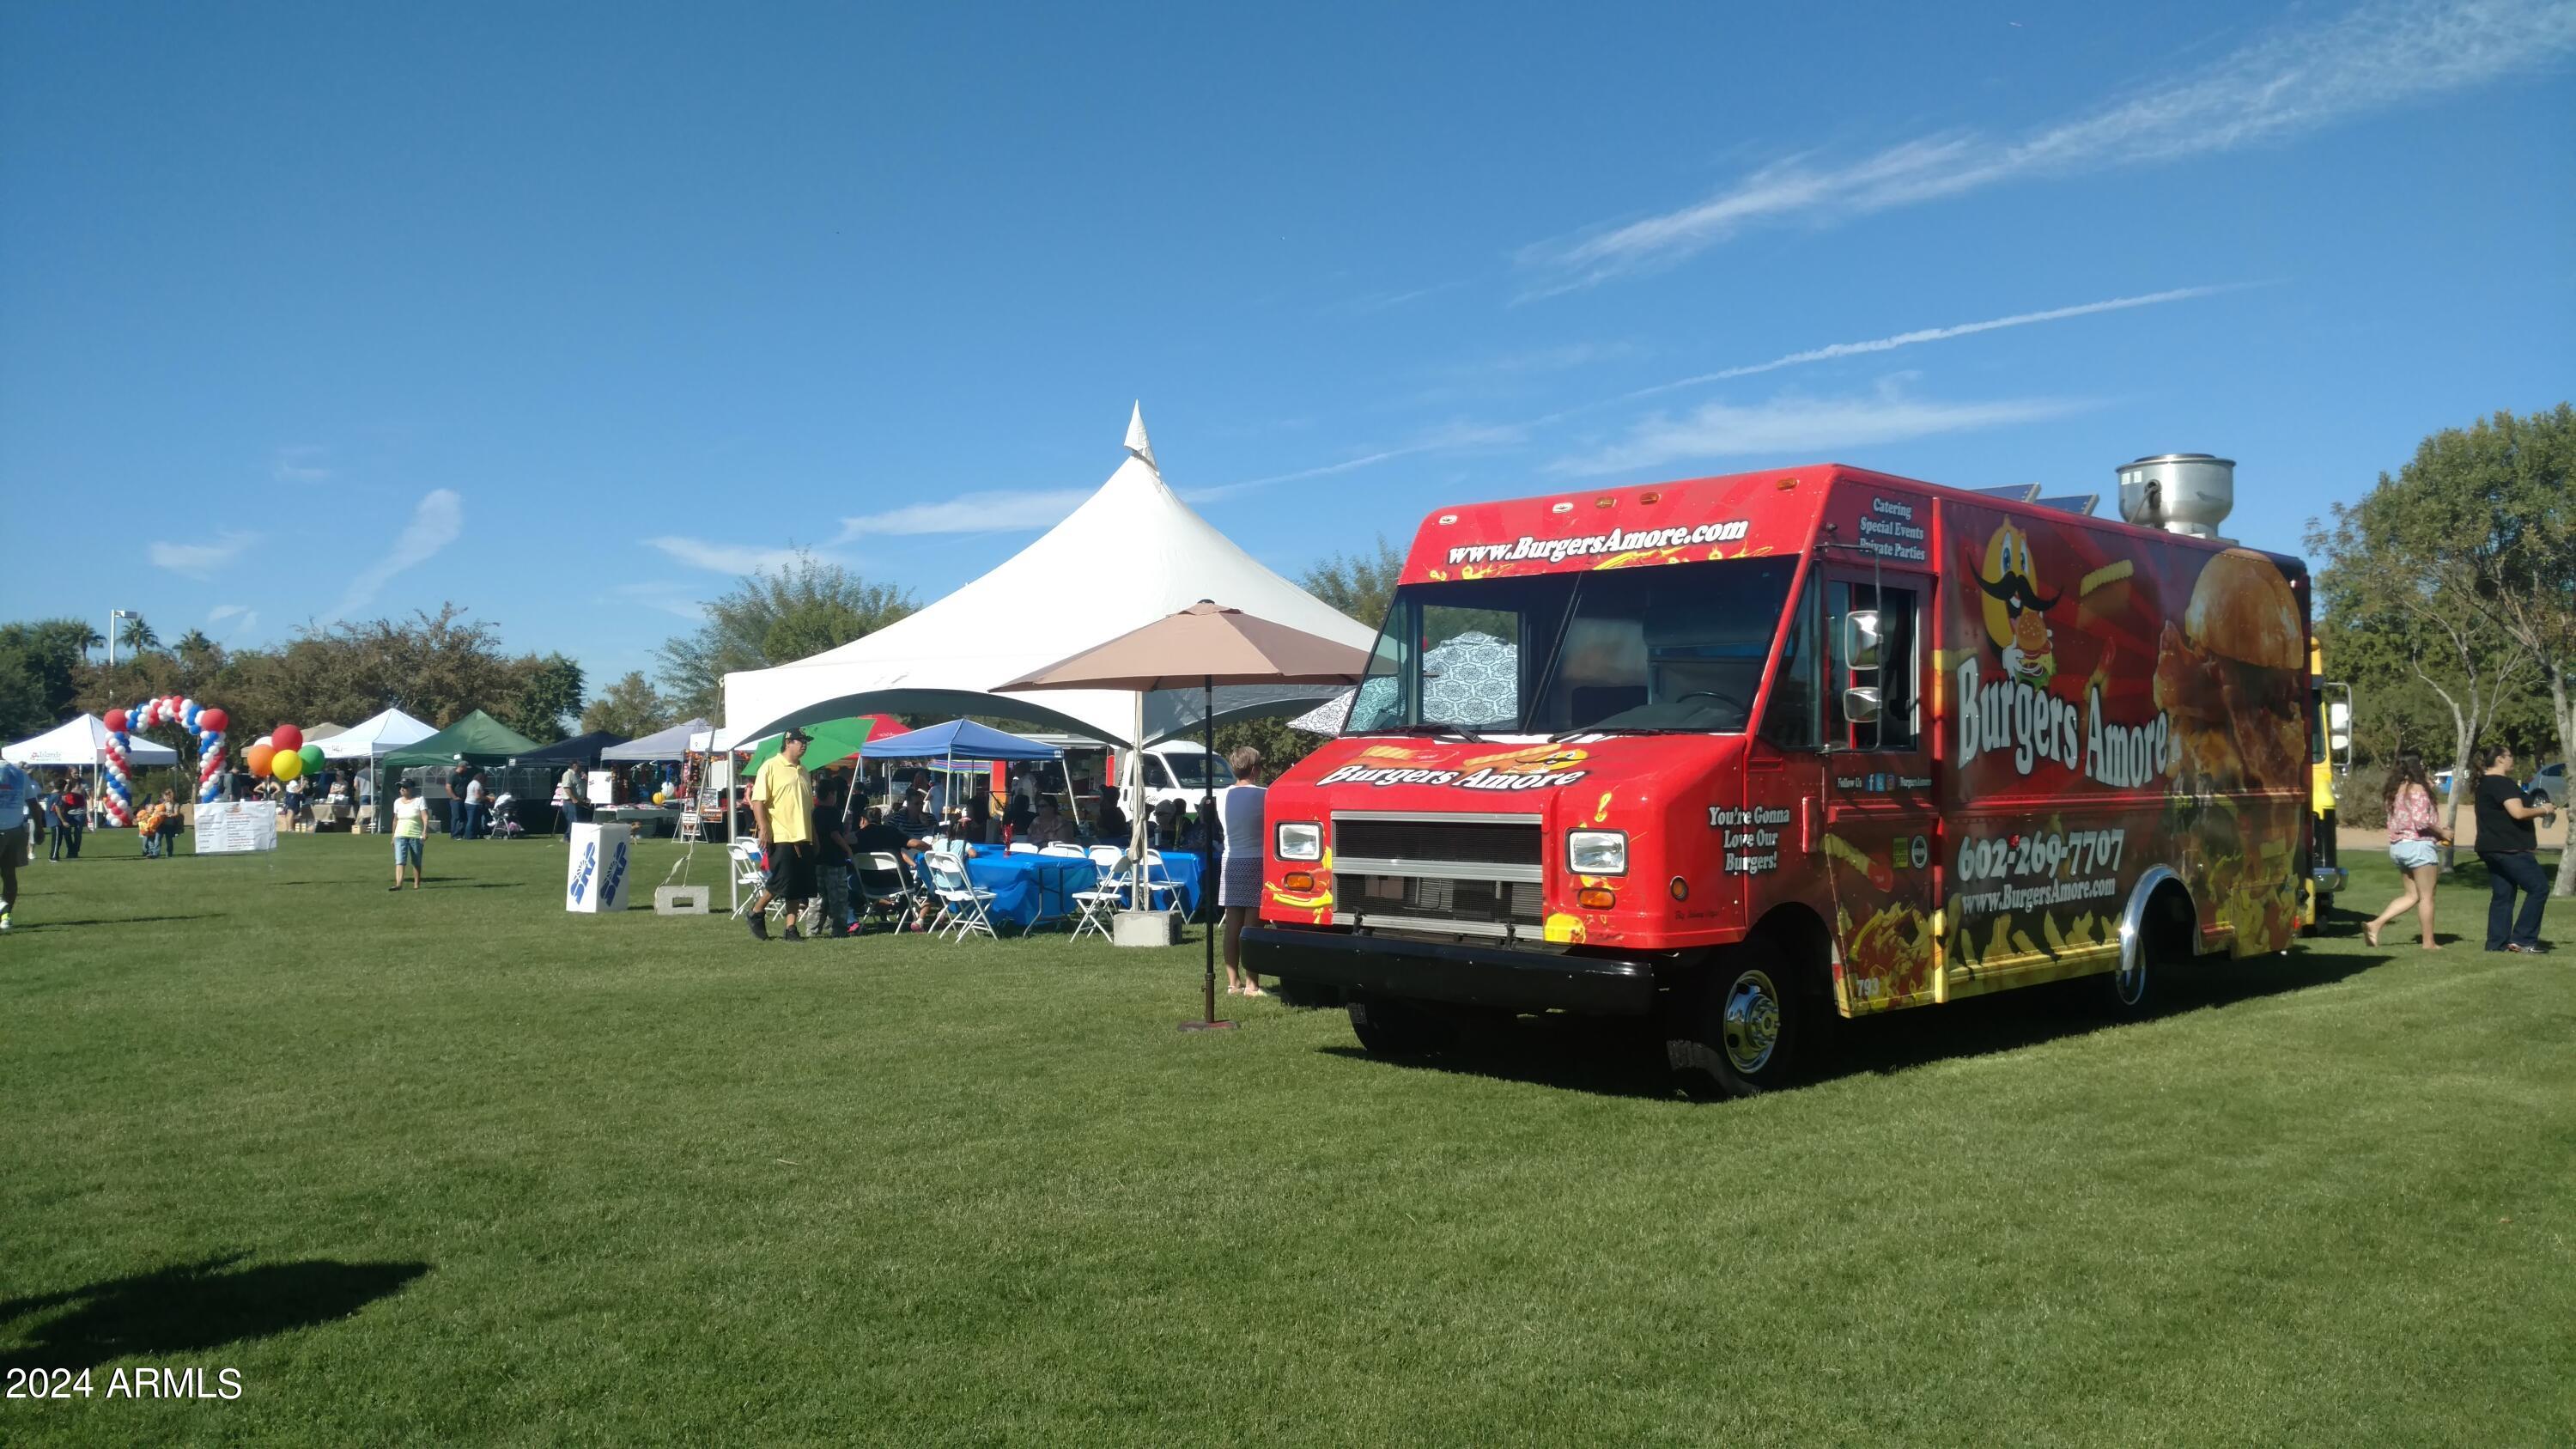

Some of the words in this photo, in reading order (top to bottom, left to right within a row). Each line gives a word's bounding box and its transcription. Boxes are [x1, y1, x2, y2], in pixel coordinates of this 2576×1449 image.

[1873, 497, 1912, 521] Catering
[1860, 516, 1893, 534] Special
[1894, 522, 1924, 540] Events
[1449, 519, 1749, 564] www.BurgersAmore.com
[1860, 538, 1893, 556] Private
[1894, 543, 1925, 561] Parties
[1957, 656, 2079, 775] Burgers
[2085, 686, 2168, 788] Amore
[1315, 764, 1461, 787] Burgers
[1452, 768, 1586, 790] Amore
[1709, 806, 1752, 825] You're
[1753, 806, 1789, 825] Gonna
[1723, 829, 1754, 849] Love
[1756, 828, 1778, 847] Our
[1724, 850, 1777, 874] Burgers!
[1957, 828, 2125, 882] 602-269-7707
[1961, 877, 2116, 915] www.BurgersAmore.com
